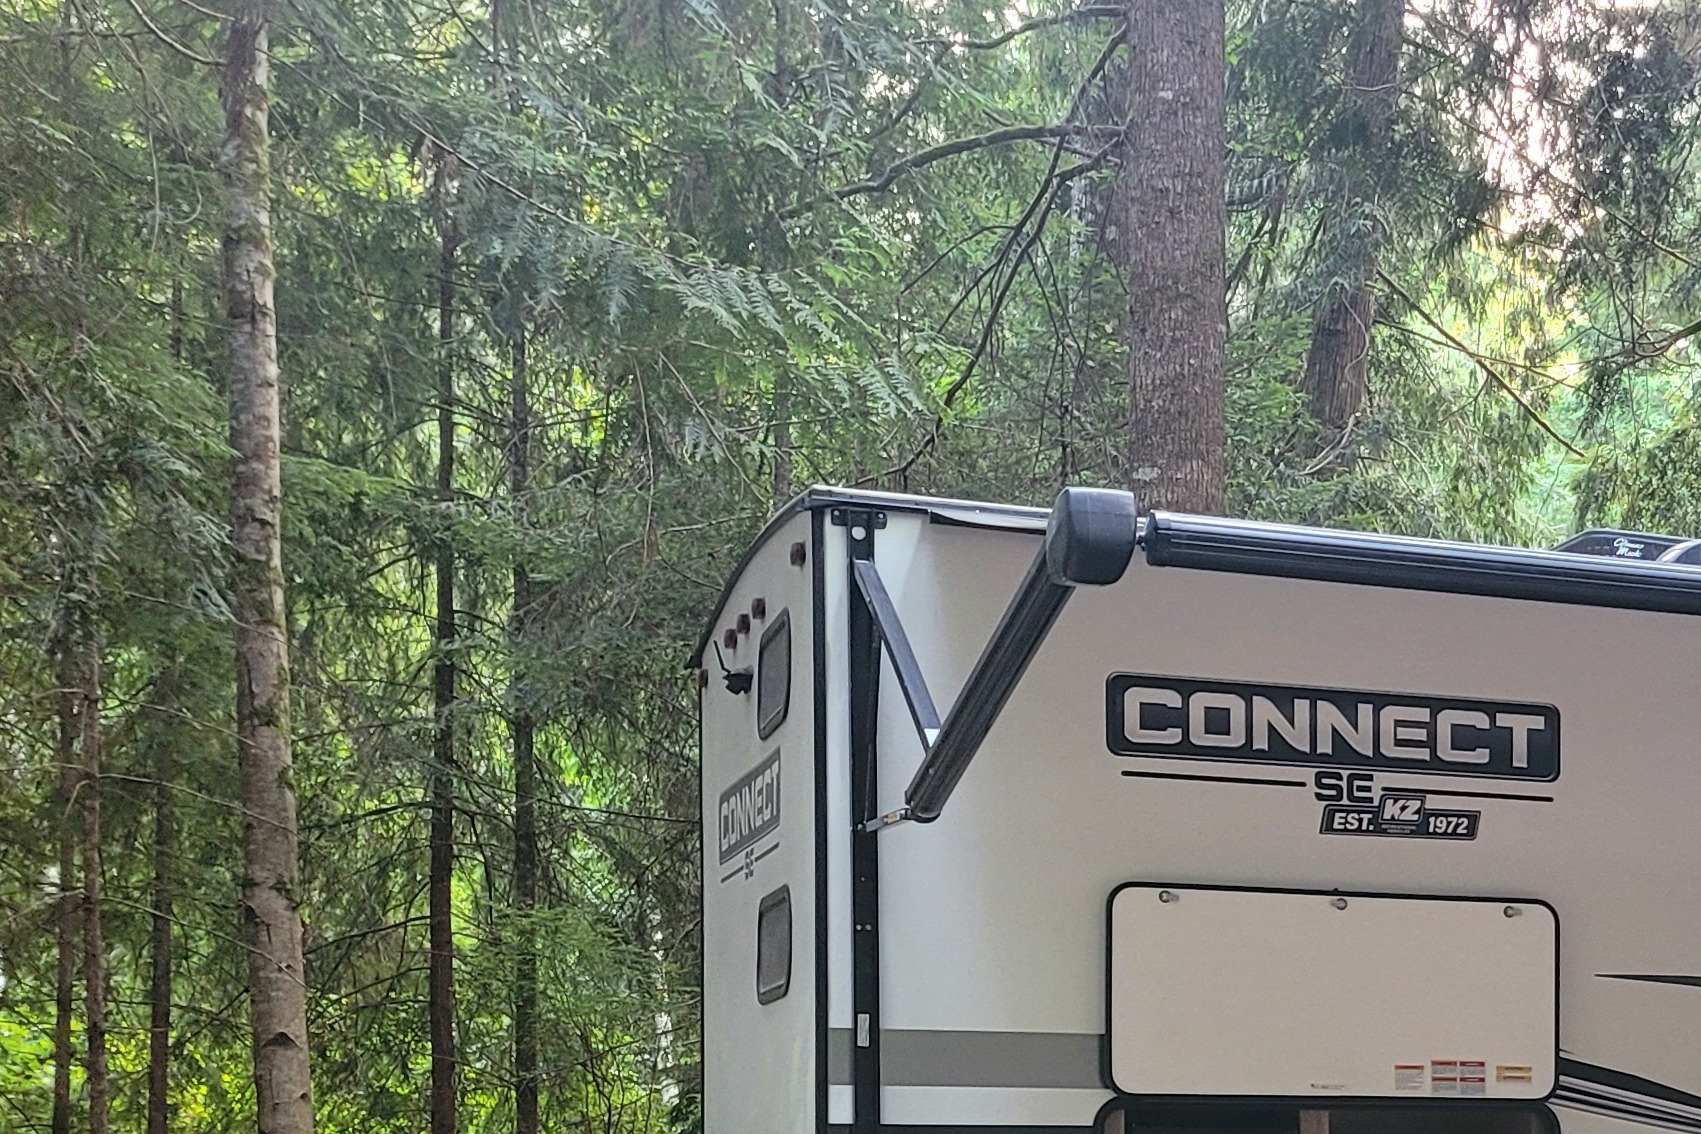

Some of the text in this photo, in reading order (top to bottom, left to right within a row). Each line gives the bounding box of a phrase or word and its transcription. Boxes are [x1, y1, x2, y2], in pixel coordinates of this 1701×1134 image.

[1123, 686, 1546, 768] CONNECT
[720, 759, 779, 852] CONNECT
[1314, 771, 1374, 804] SE
[1332, 812, 1375, 831] EST.
[1382, 799, 1420, 820] KZ
[1428, 816, 1470, 834] 1972
